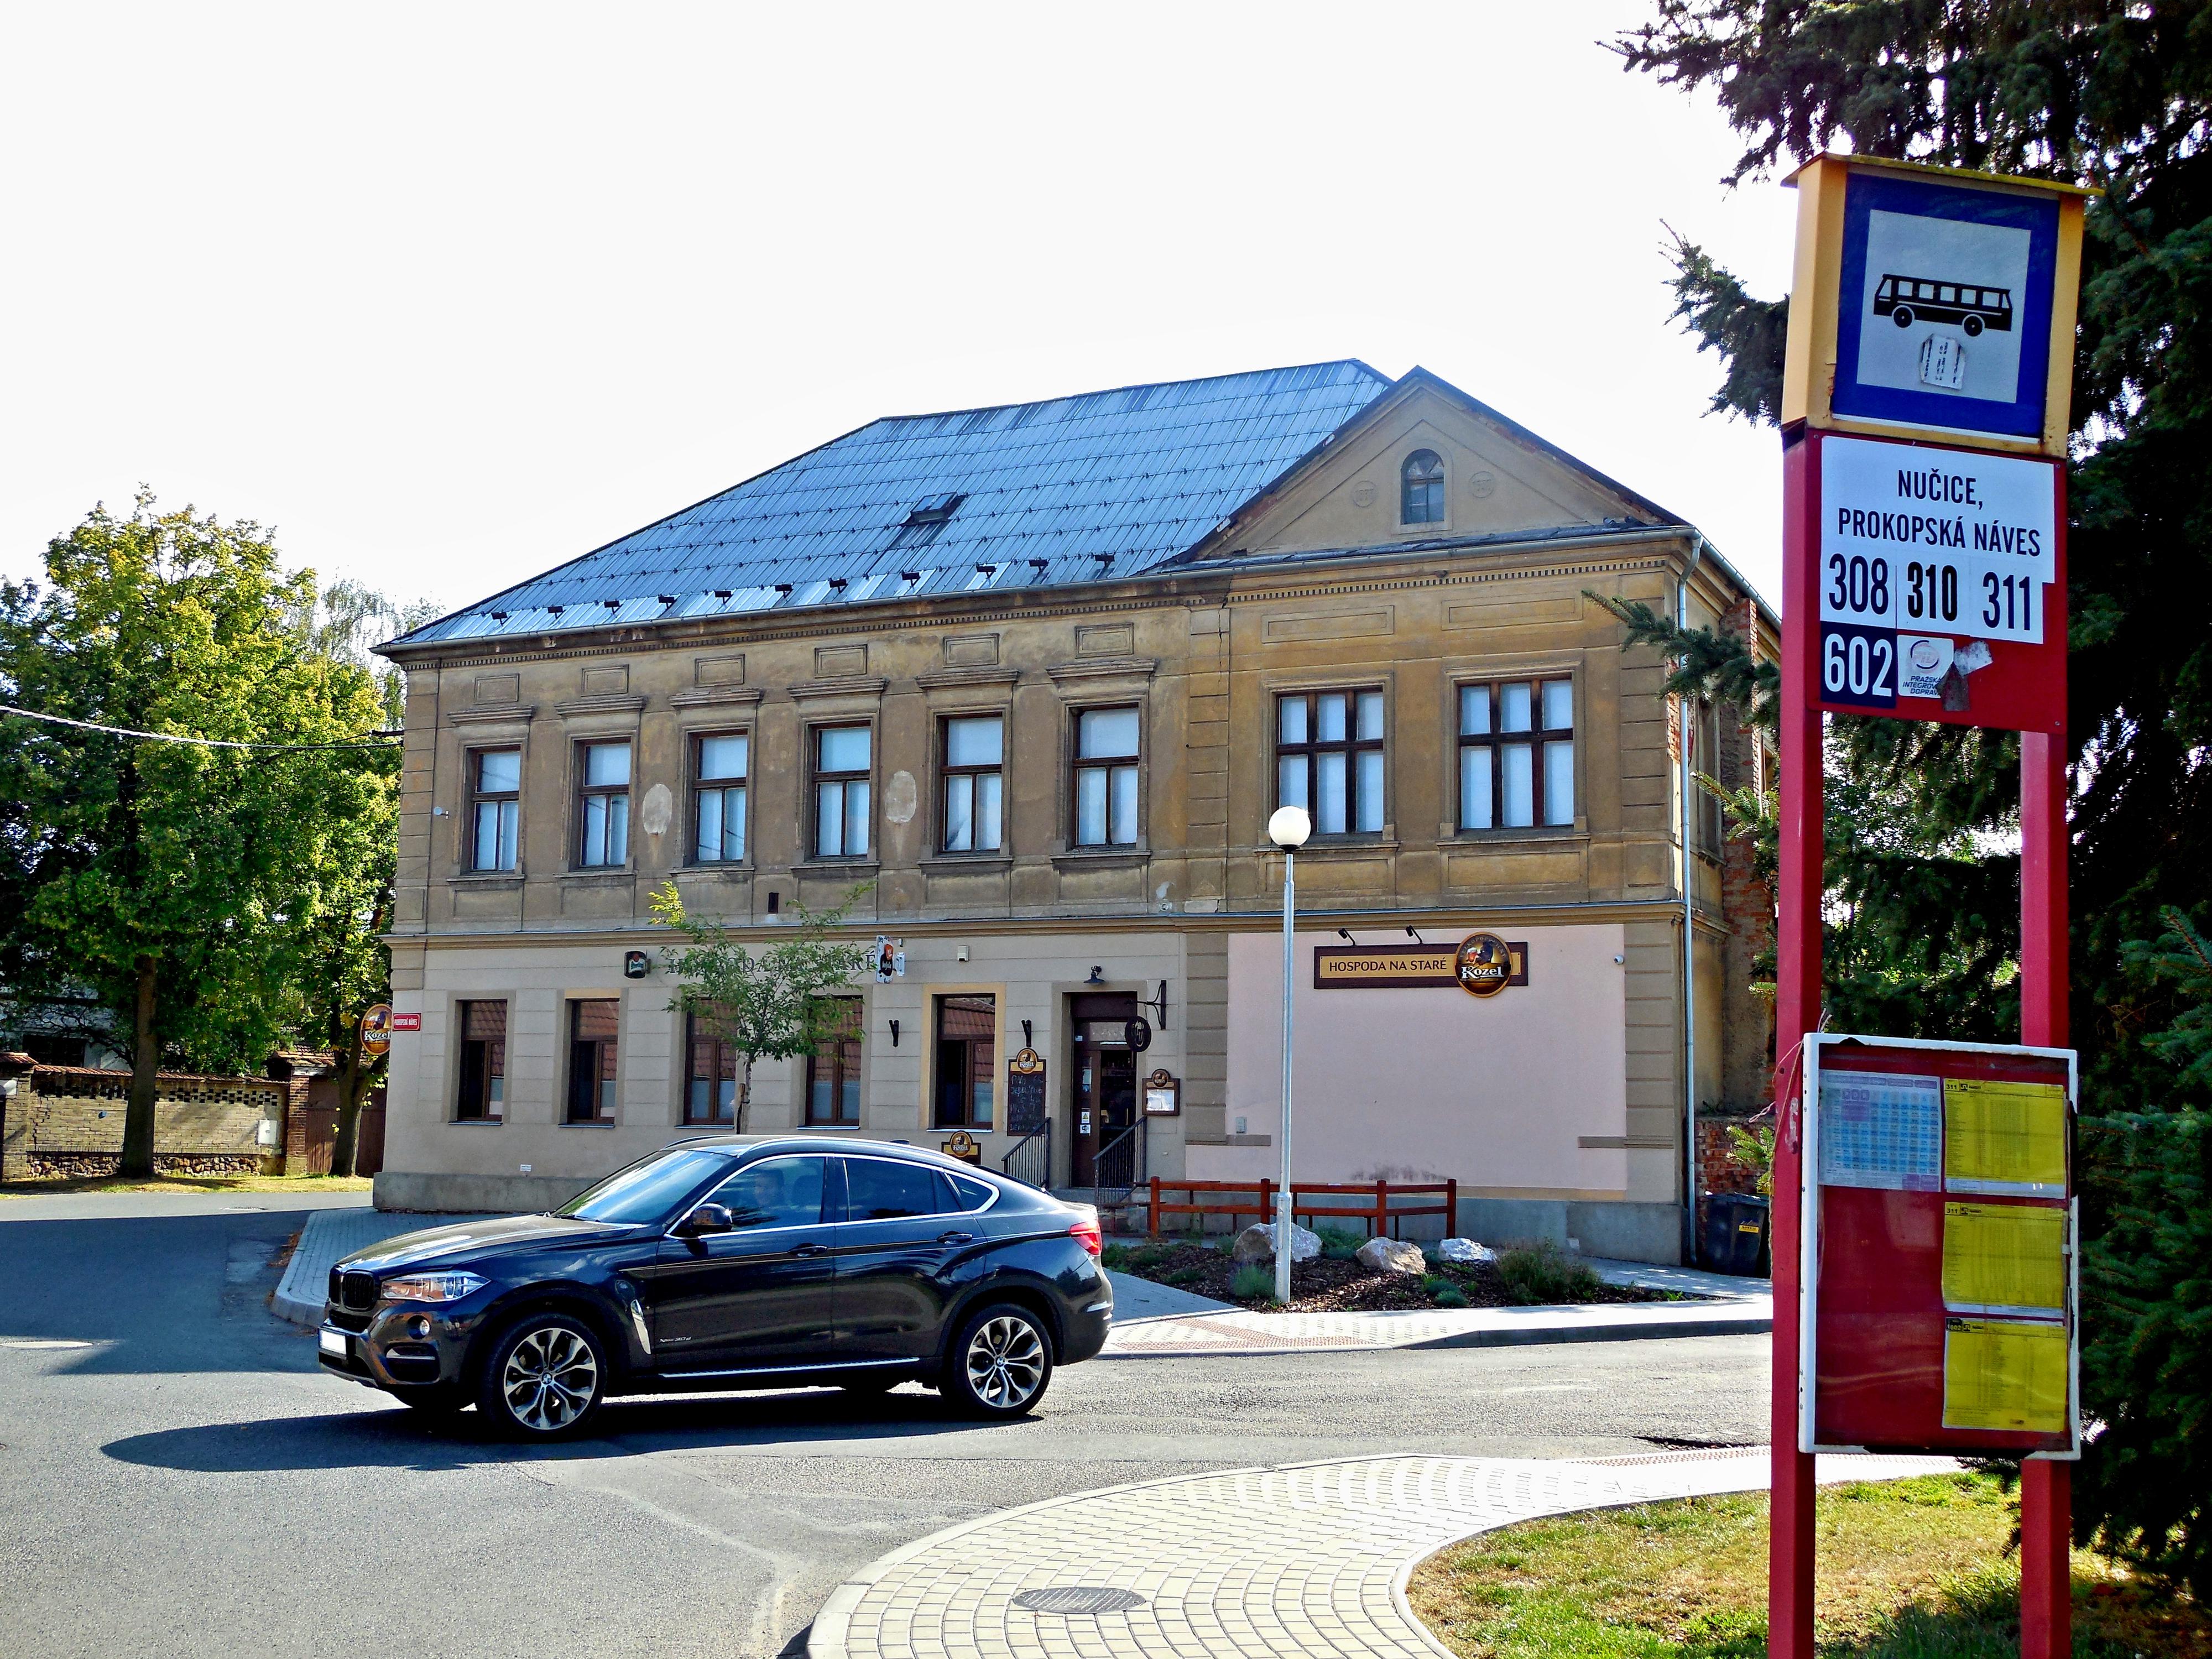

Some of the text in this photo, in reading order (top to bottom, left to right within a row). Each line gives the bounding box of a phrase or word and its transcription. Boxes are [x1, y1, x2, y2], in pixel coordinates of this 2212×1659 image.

[1898, 468, 1983, 509] NUČICE,
[1839, 508, 2041, 557] PROKOPSKÁ NÁVES
[1829, 554, 2031, 630] 308 310 311
[1825, 633, 1892, 697] 602
[1329, 957, 1447, 972] HOSPODA NA STARÉ
[1461, 966, 1504, 979] Kozel
